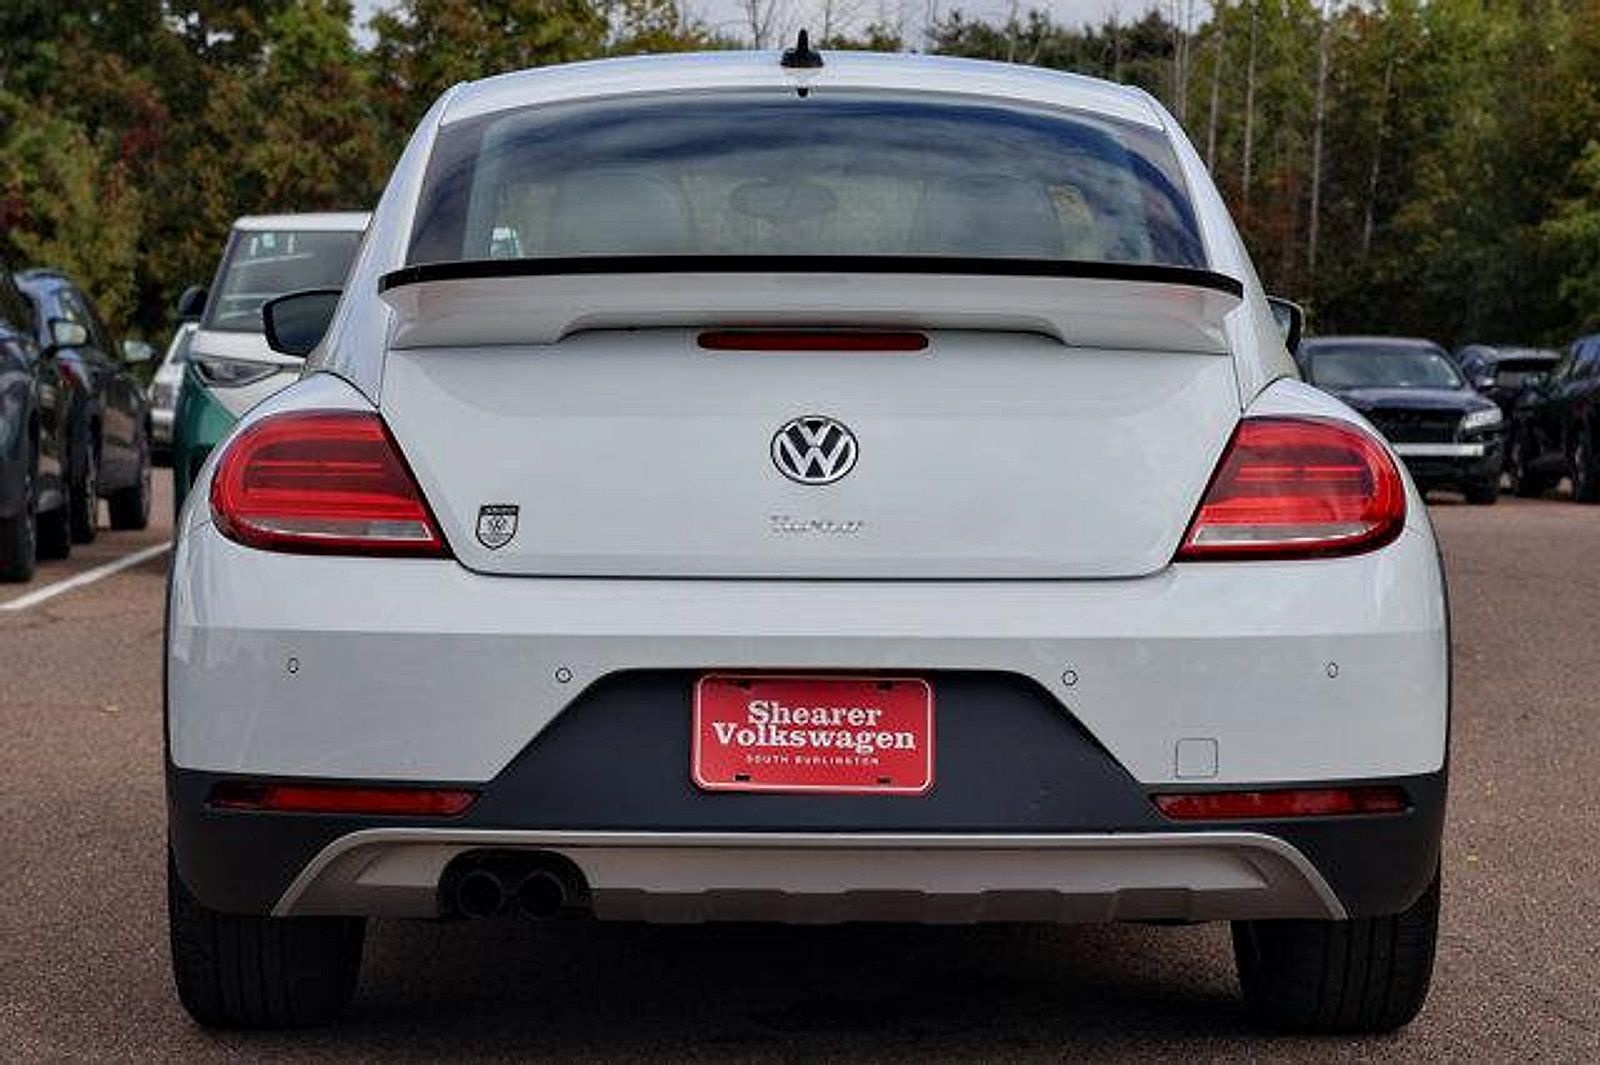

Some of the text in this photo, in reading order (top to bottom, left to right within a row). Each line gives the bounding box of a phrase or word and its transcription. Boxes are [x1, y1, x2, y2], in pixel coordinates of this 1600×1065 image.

[748, 700, 882, 726] Shearer
[713, 722, 916, 754] Volkswagen
[745, 754, 788, 764] SOUTH
